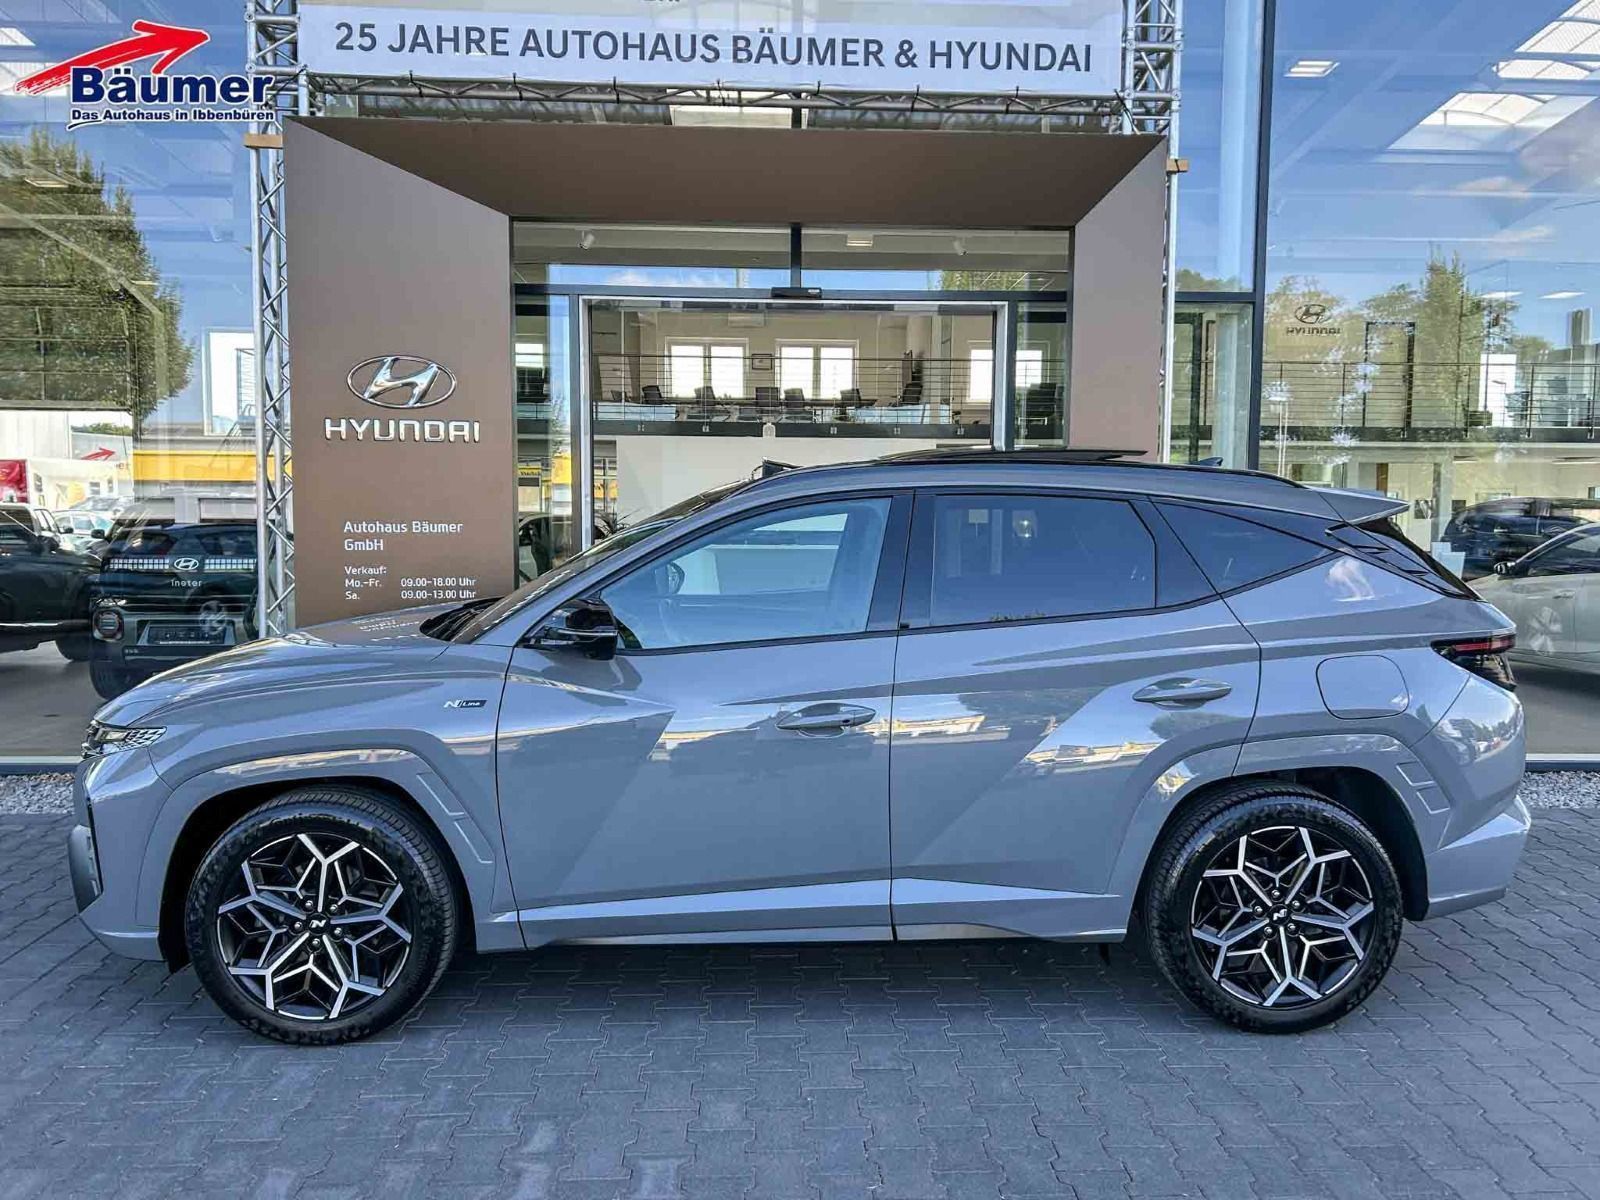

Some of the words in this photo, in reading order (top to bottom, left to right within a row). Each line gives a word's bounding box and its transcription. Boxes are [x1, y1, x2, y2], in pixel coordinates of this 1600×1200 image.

[335, 22, 377, 52] 25
[387, 23, 509, 57] JAHRE
[519, 28, 720, 63] AUTOHAUS
[731, 27, 885, 68] BÄUMER
[894, 38, 919, 68] &
[929, 40, 1091, 73] HYUNDAI
[324, 417, 481, 443] HYUNDAI
[343, 520, 408, 533] Autohaus
[412, 520, 463, 533] Bäumer
[344, 538, 384, 551] GmbH
[344, 565, 387, 575] Verkauf:
[459, 577, 477, 587] Uhr
[345, 590, 360, 600] Sa.
[459, 590, 477, 599] Uhr
